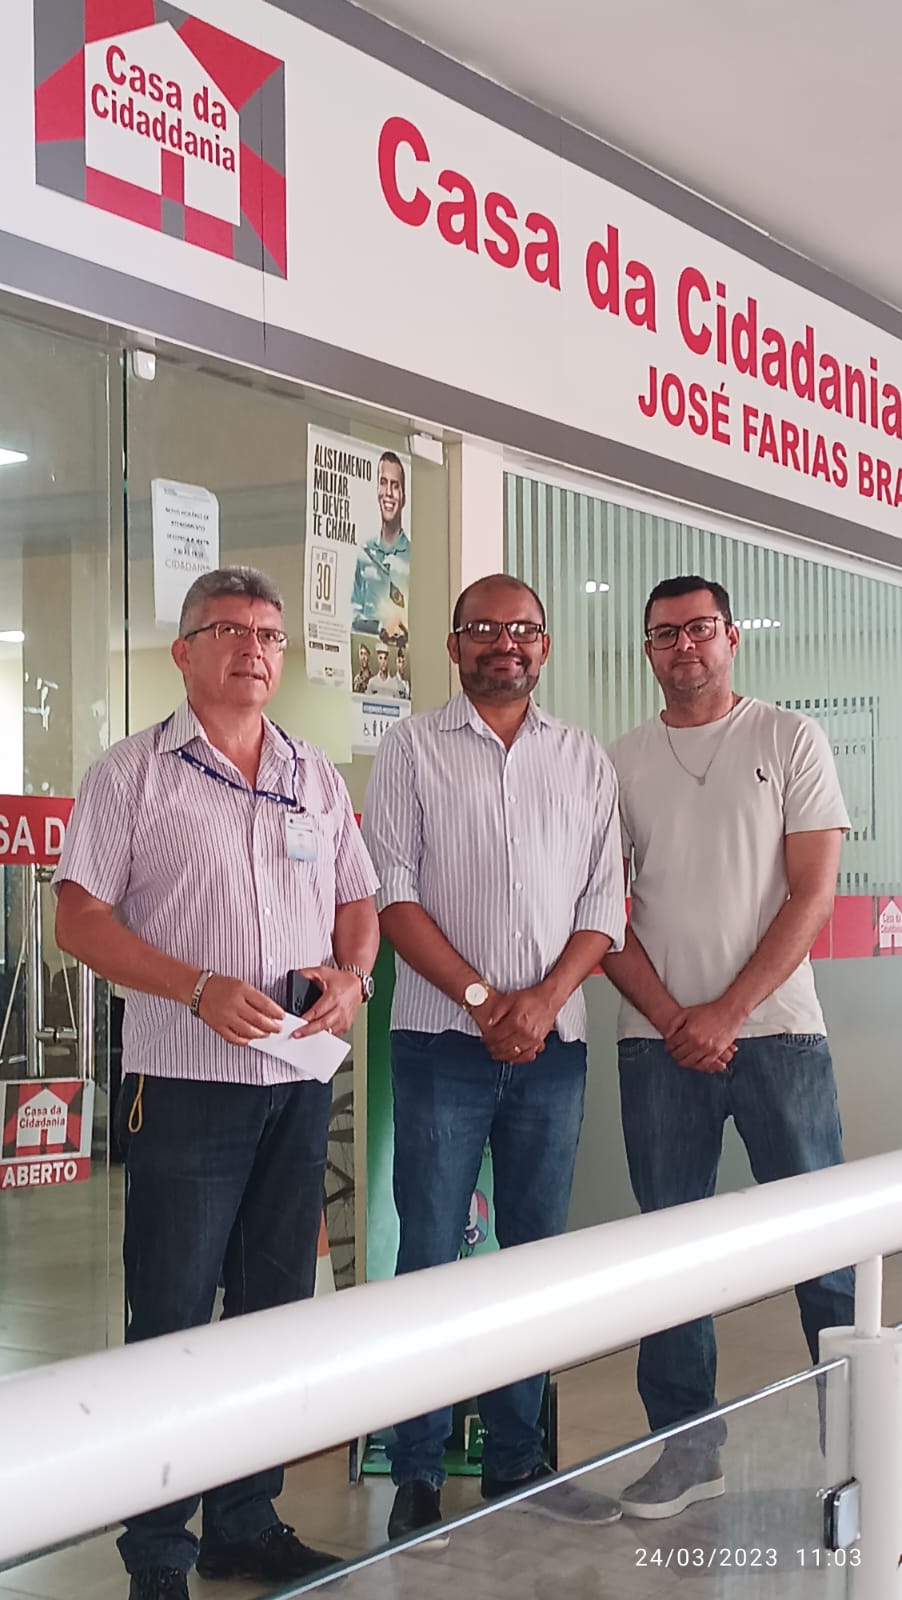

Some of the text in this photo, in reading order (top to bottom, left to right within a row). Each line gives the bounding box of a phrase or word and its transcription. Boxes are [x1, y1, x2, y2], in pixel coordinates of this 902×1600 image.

[106, 45, 227, 131] Casa da
[378, 116, 902, 440] Casa da Cidadania
[638, 365, 731, 446] JOSÉ
[743, 404, 848, 488] FARIAS
[314, 444, 372, 481] ALISTAMENTO
[313, 491, 350, 520] O DEVER
[313, 514, 322, 537] TE
[316, 562, 331, 601] 30
[20, 1117, 65, 1128] Cidadania
[25, 1105, 61, 1116] Casa da
[2, 1161, 77, 1188] ABERTO
